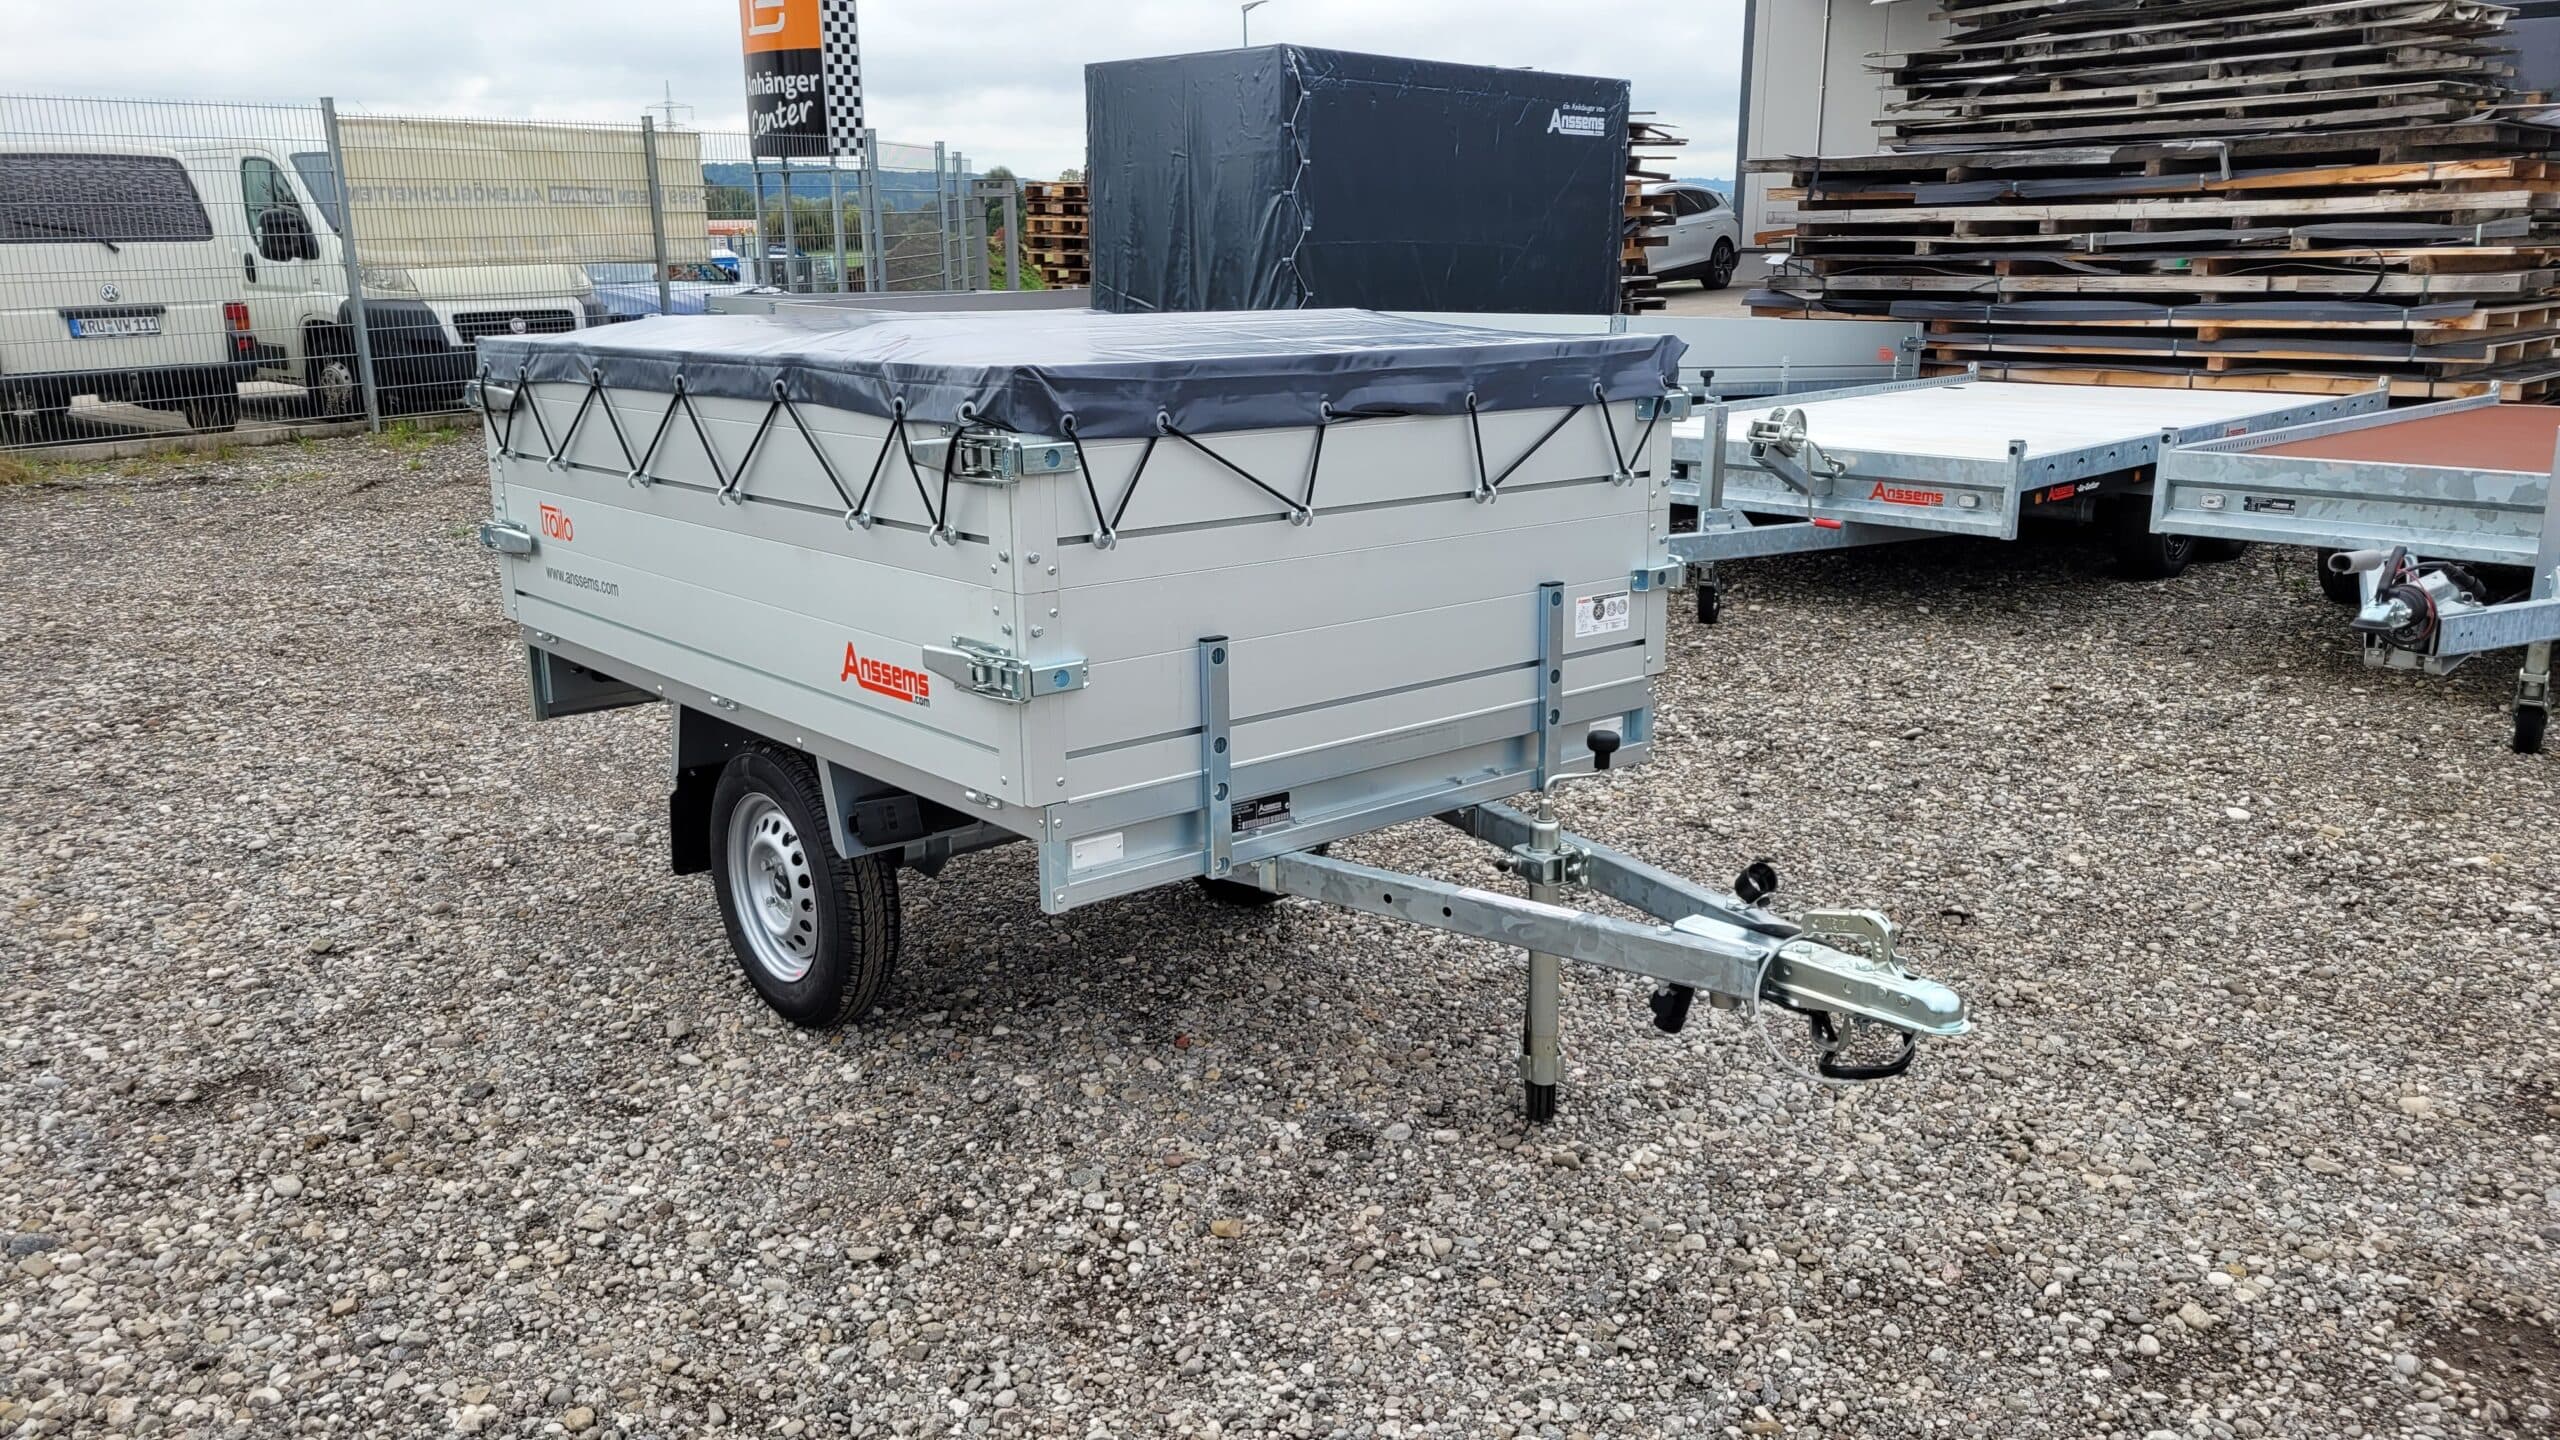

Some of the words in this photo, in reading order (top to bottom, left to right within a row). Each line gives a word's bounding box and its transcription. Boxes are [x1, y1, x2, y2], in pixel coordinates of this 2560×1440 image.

[748, 71, 819, 99] Anhänger
[752, 100, 813, 139] Center
[1547, 108, 1605, 134] Anssems
[1868, 481, 1944, 505] Anssems
[546, 566, 619, 597] www.anssems.com
[841, 640, 929, 702] Anssems
